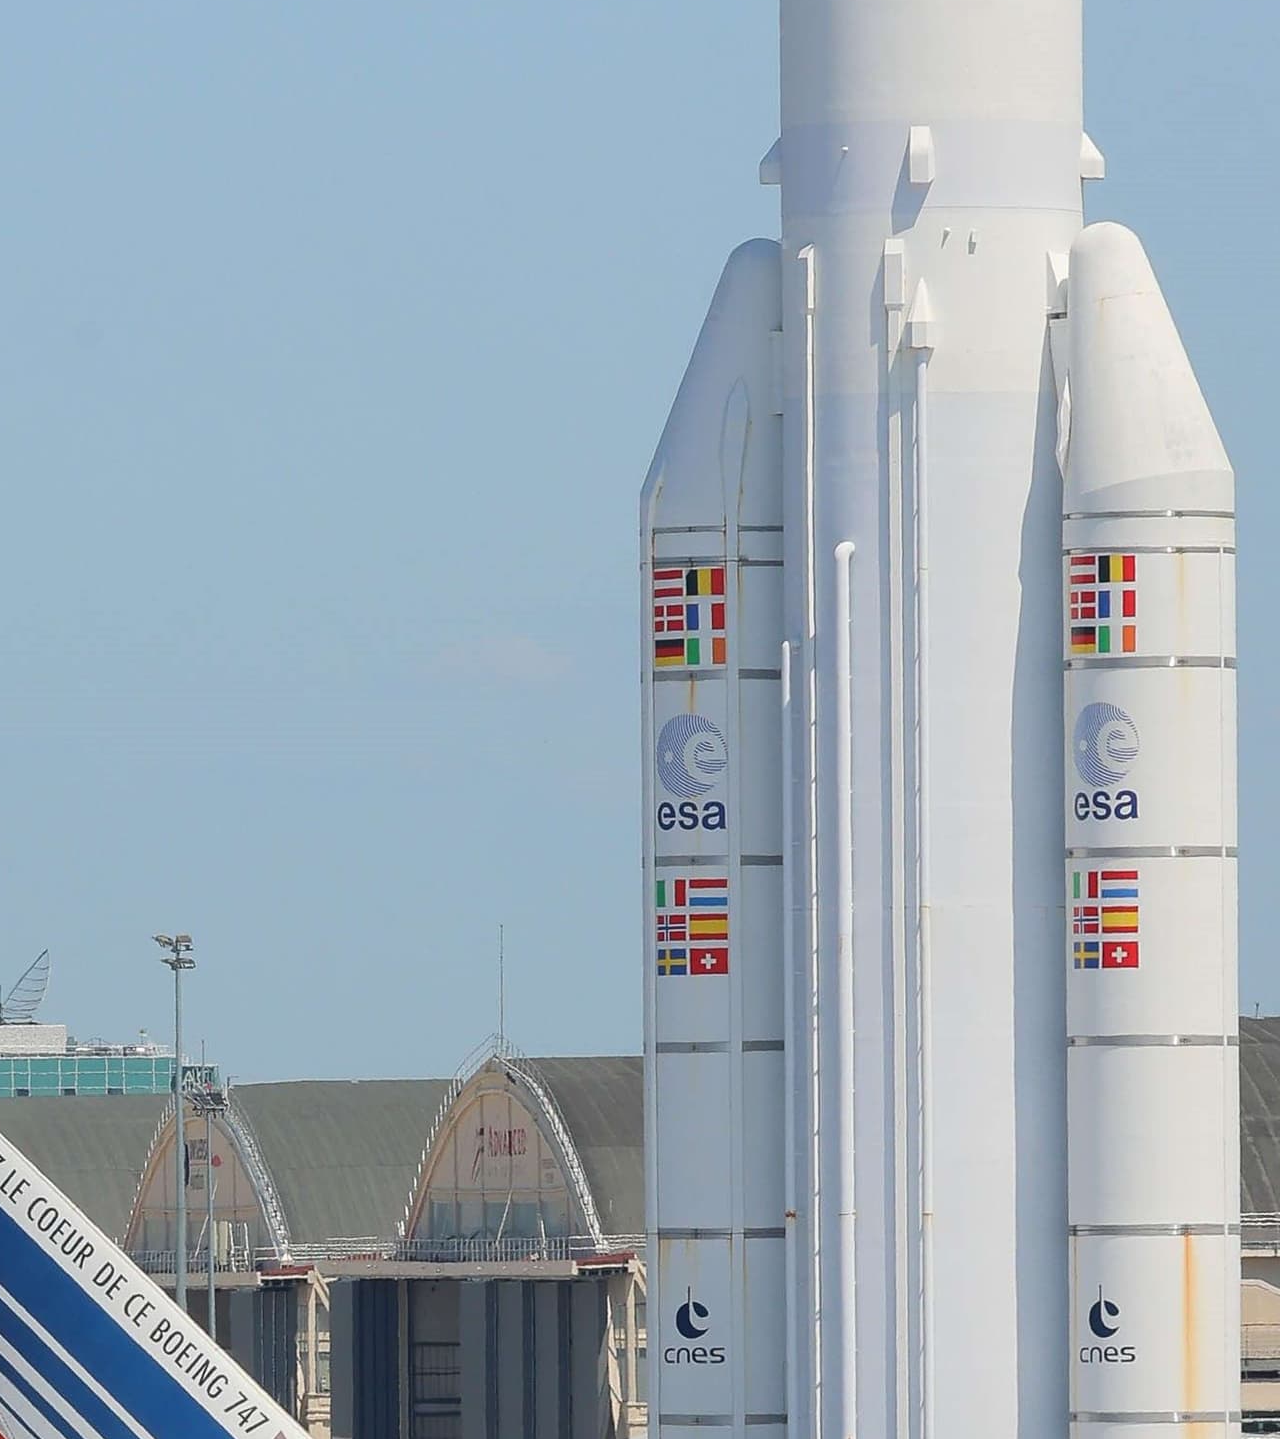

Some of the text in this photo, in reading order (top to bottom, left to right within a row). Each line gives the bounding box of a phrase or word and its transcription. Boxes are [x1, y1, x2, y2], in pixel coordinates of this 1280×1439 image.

[657, 801, 727, 831] esa
[1073, 789, 1139, 821] esa
[26, 1196, 95, 1270] COEUR
[92, 1261, 129, 1301] DE
[123, 1293, 157, 1328] CE
[149, 1318, 230, 1400] BOEING
[223, 1390, 271, 1434] 747
[664, 1347, 726, 1364] cnes
[1080, 1346, 1137, 1363] cnes
